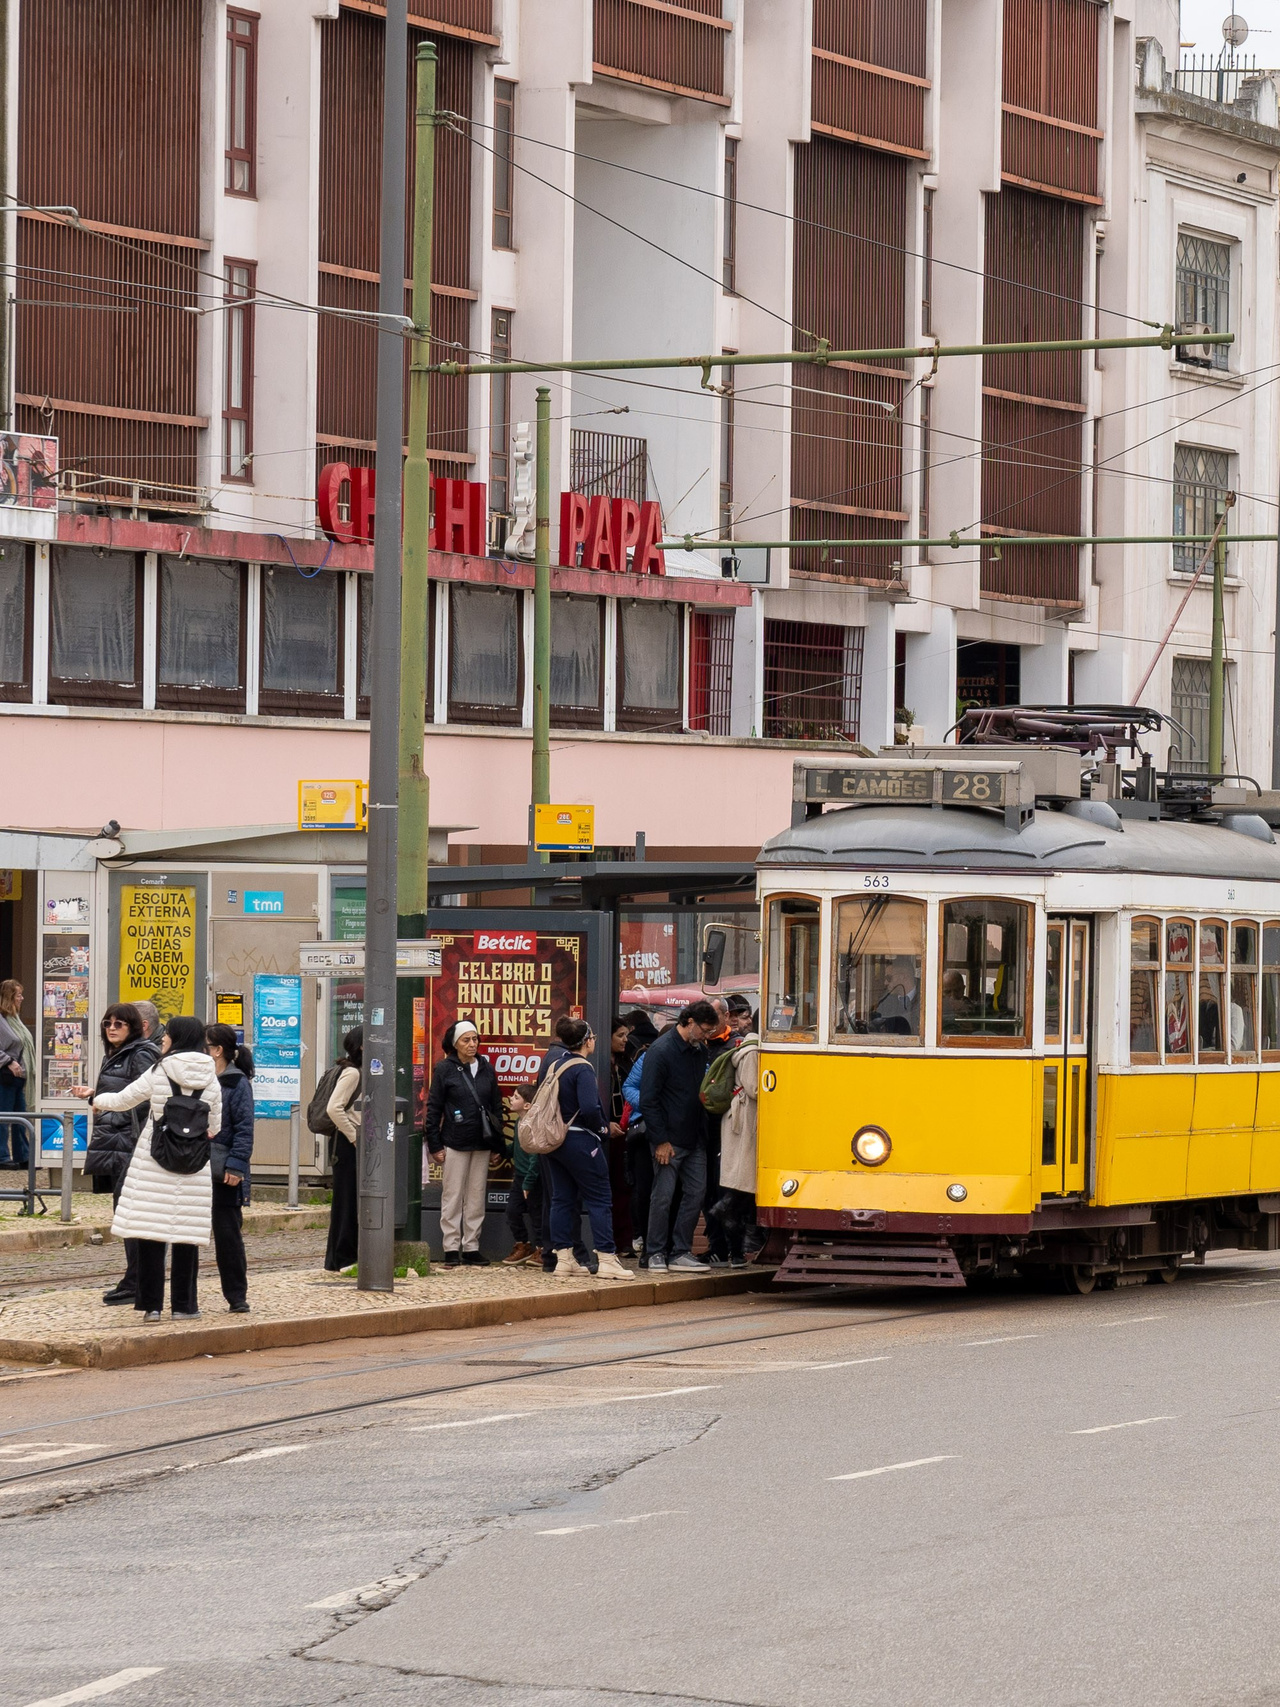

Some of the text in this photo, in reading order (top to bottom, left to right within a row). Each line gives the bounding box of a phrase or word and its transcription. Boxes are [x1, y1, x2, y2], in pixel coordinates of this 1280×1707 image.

[560, 492, 666, 576] PAPA
[953, 774, 991, 799] 28
[863, 876, 890, 888] 563
[134, 893, 187, 905] ESCUTA
[253, 899, 281, 911] tmn
[129, 906, 191, 918] EXTERNA
[127, 926, 191, 938] QUANTAS
[137, 938, 182, 950] IDEIAS
[477, 935, 532, 951] Betclic
[135, 951, 183, 963] CABEM
[628, 951, 660, 969] TÉNIS
[127, 964, 190, 976] NO NOVO
[459, 962, 552, 983] CELEBRA O
[130, 977, 187, 989] MUSEU?
[457, 983, 551, 1005] ANO NOVO
[665, 996, 690, 1005] Alfama
[261, 1016, 287, 1028] 20GB
[279, 1049, 294, 1057] Lyca
[254, 1075, 299, 1085] 30GB 40GB
